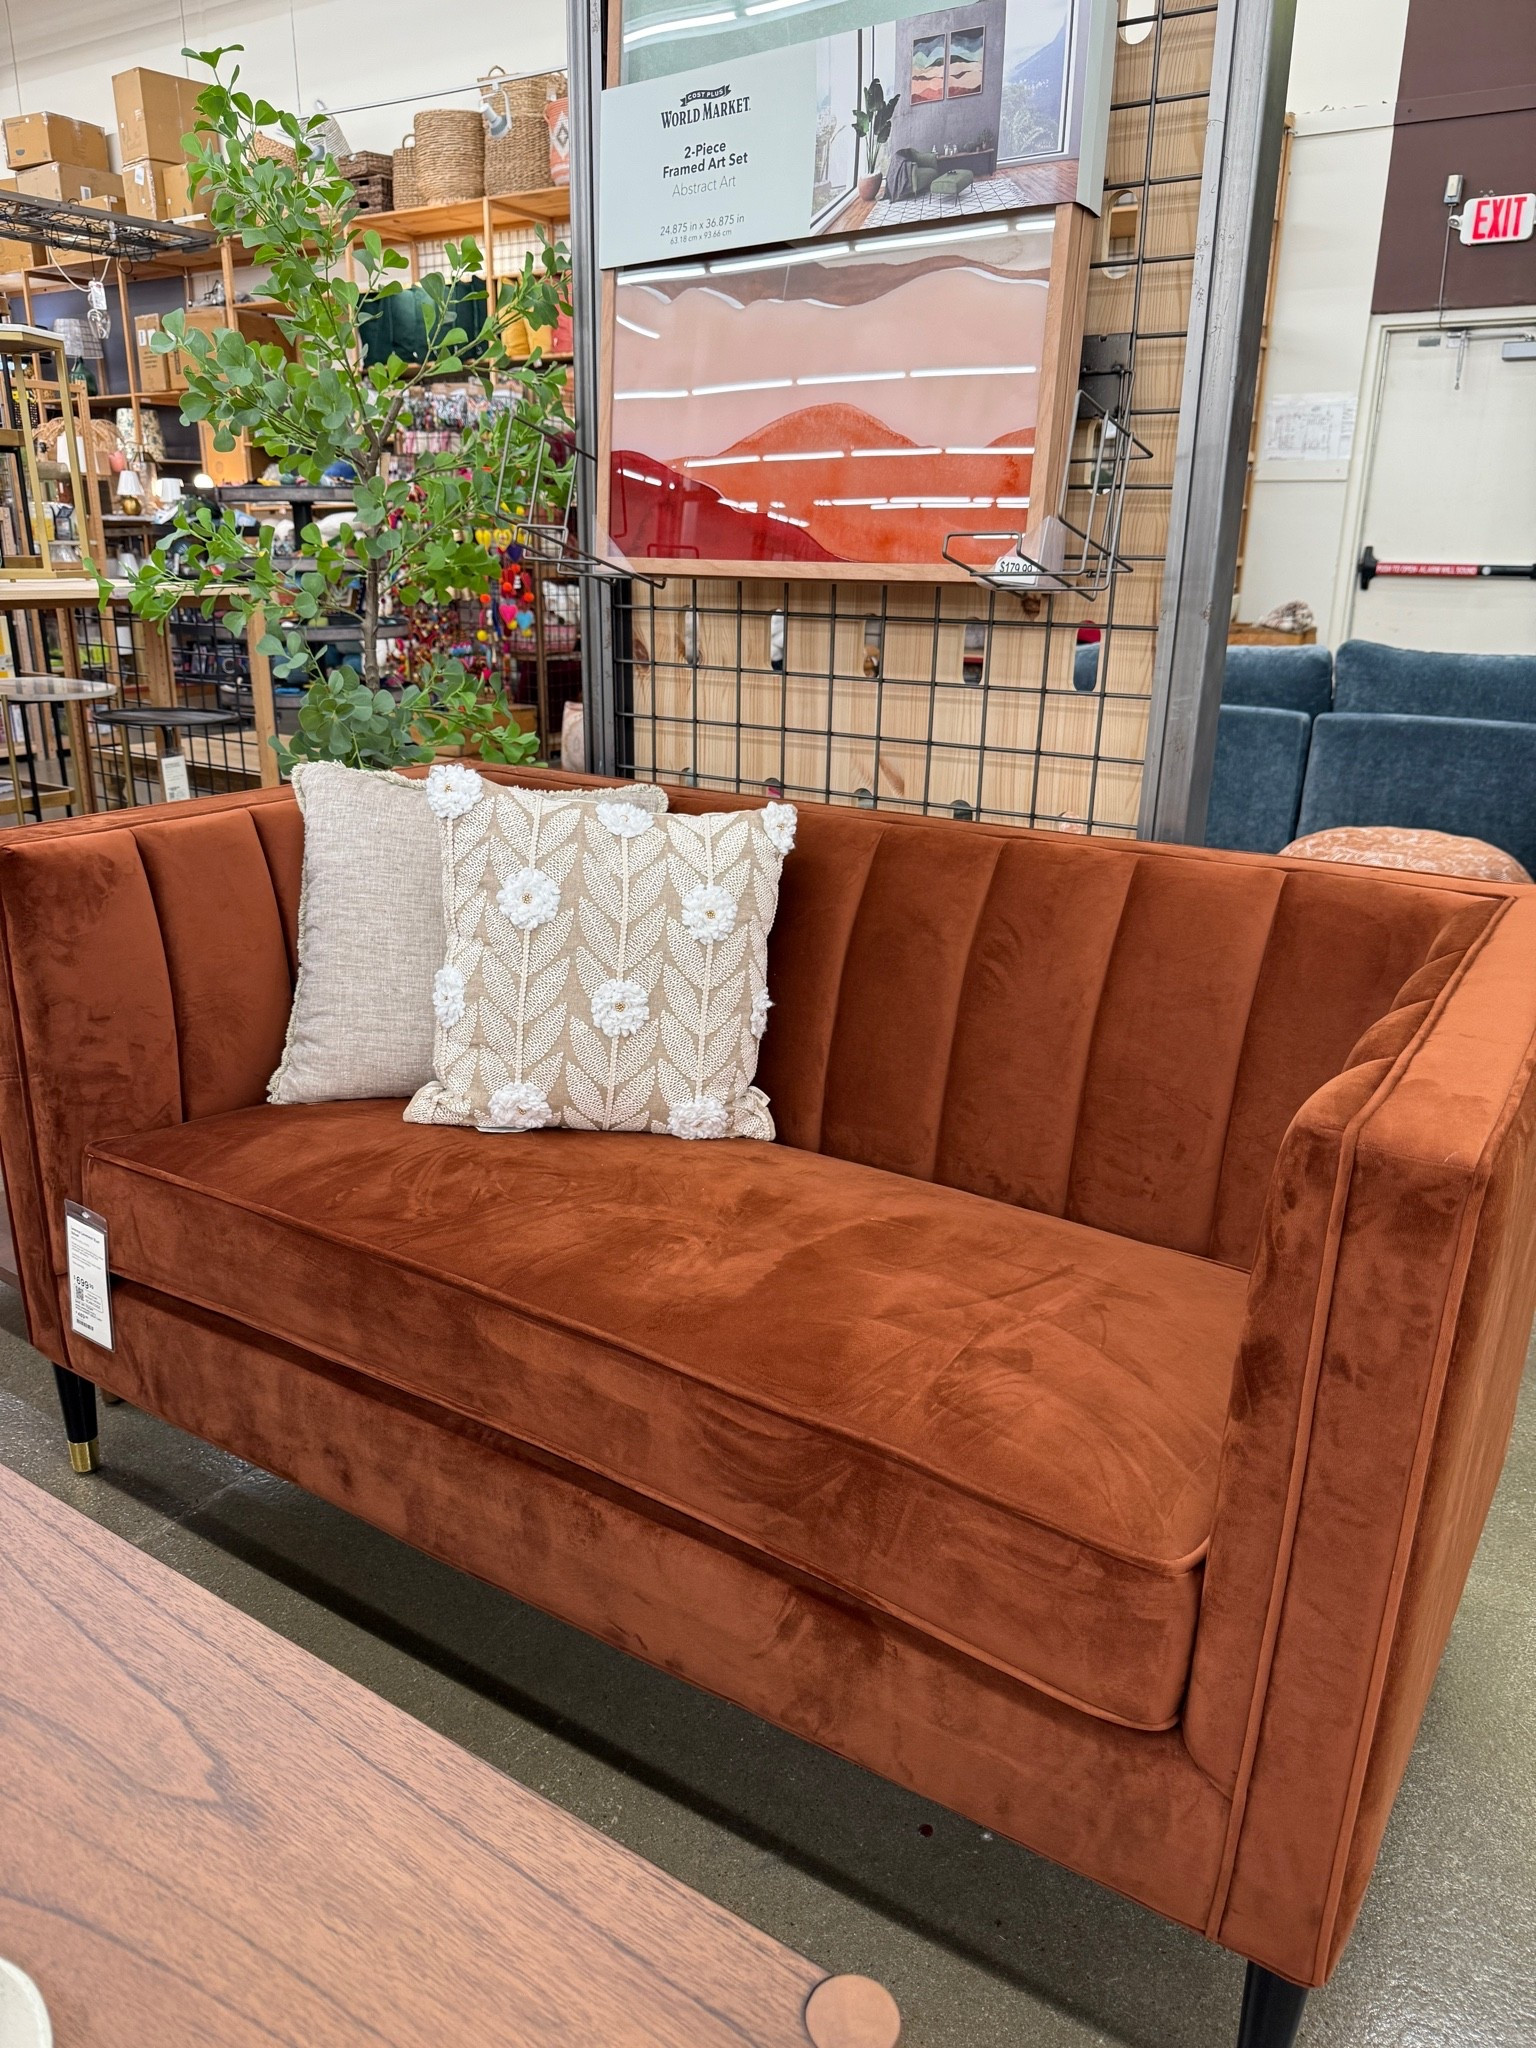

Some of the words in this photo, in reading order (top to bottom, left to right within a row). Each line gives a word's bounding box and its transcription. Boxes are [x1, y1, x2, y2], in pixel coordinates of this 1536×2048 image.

[687, 91, 706, 101] COST
[706, 88, 724, 98] PLUS
[660, 108, 700, 129] WORLD
[702, 96, 751, 121] MARKET
[684, 141, 726, 159] 2-Piece
[662, 158, 705, 179] Framed
[707, 156, 726, 170] Art
[728, 152, 748, 166] Set
[672, 179, 717, 197] Abstract
[719, 175, 736, 189] Art
[660, 222, 688, 236] 24.875
[689, 220, 697, 230] in
[705, 215, 735, 229] 36.875
[736, 214, 745, 224] in
[1472, 196, 1527, 240] EXIT
[670, 235, 686, 245] 63.18
[703, 230, 721, 240] 93.66
[999, 561, 1033, 573] $17999
